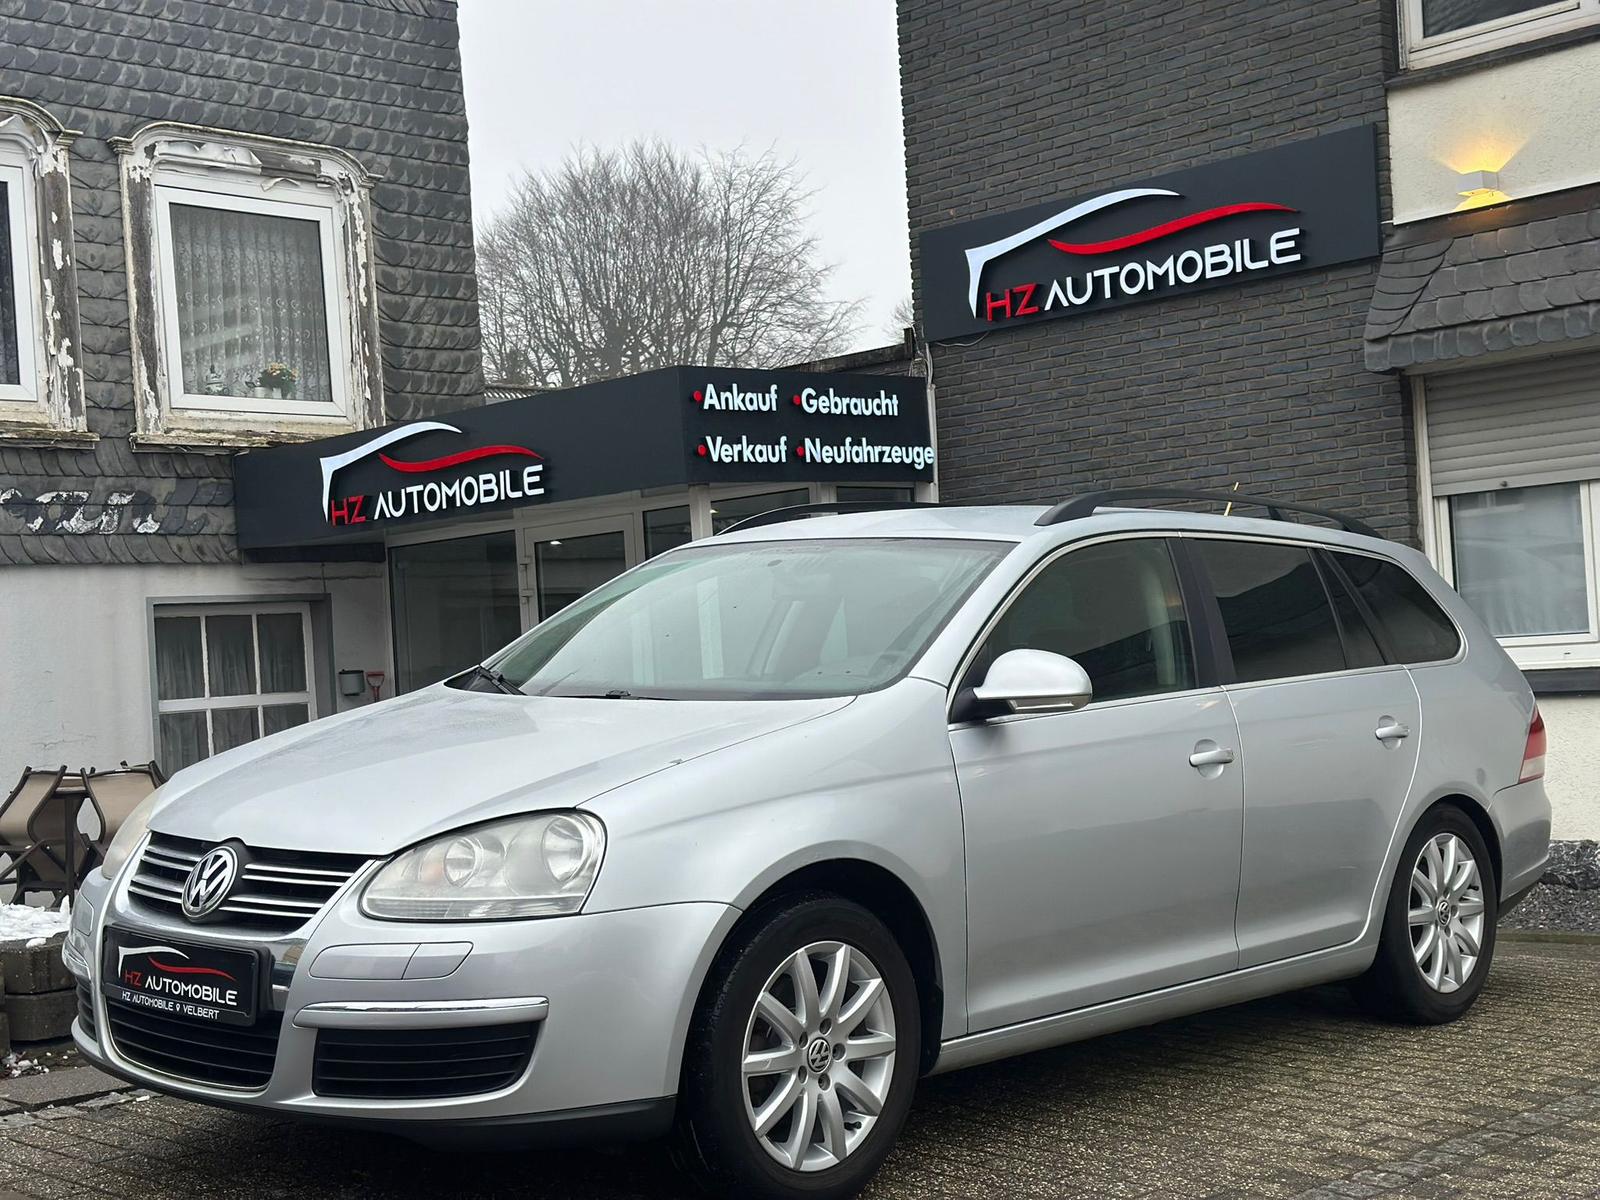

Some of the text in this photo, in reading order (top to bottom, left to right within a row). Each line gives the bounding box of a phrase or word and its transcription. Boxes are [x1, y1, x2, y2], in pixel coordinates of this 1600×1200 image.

[986, 228, 1302, 322] HZ AUTOMOBILE
[703, 383, 778, 412] Ankauf
[801, 387, 899, 416] Gebraucht
[705, 435, 788, 463] Verkauf
[804, 437, 935, 470] Neufahrzeuge
[331, 464, 545, 526] HZ AUTOMOBILE
[124, 969, 238, 1006] HZ AUTOMOBILE
[121, 990, 220, 1020] HZ AUTOMOBILE VELBERT
